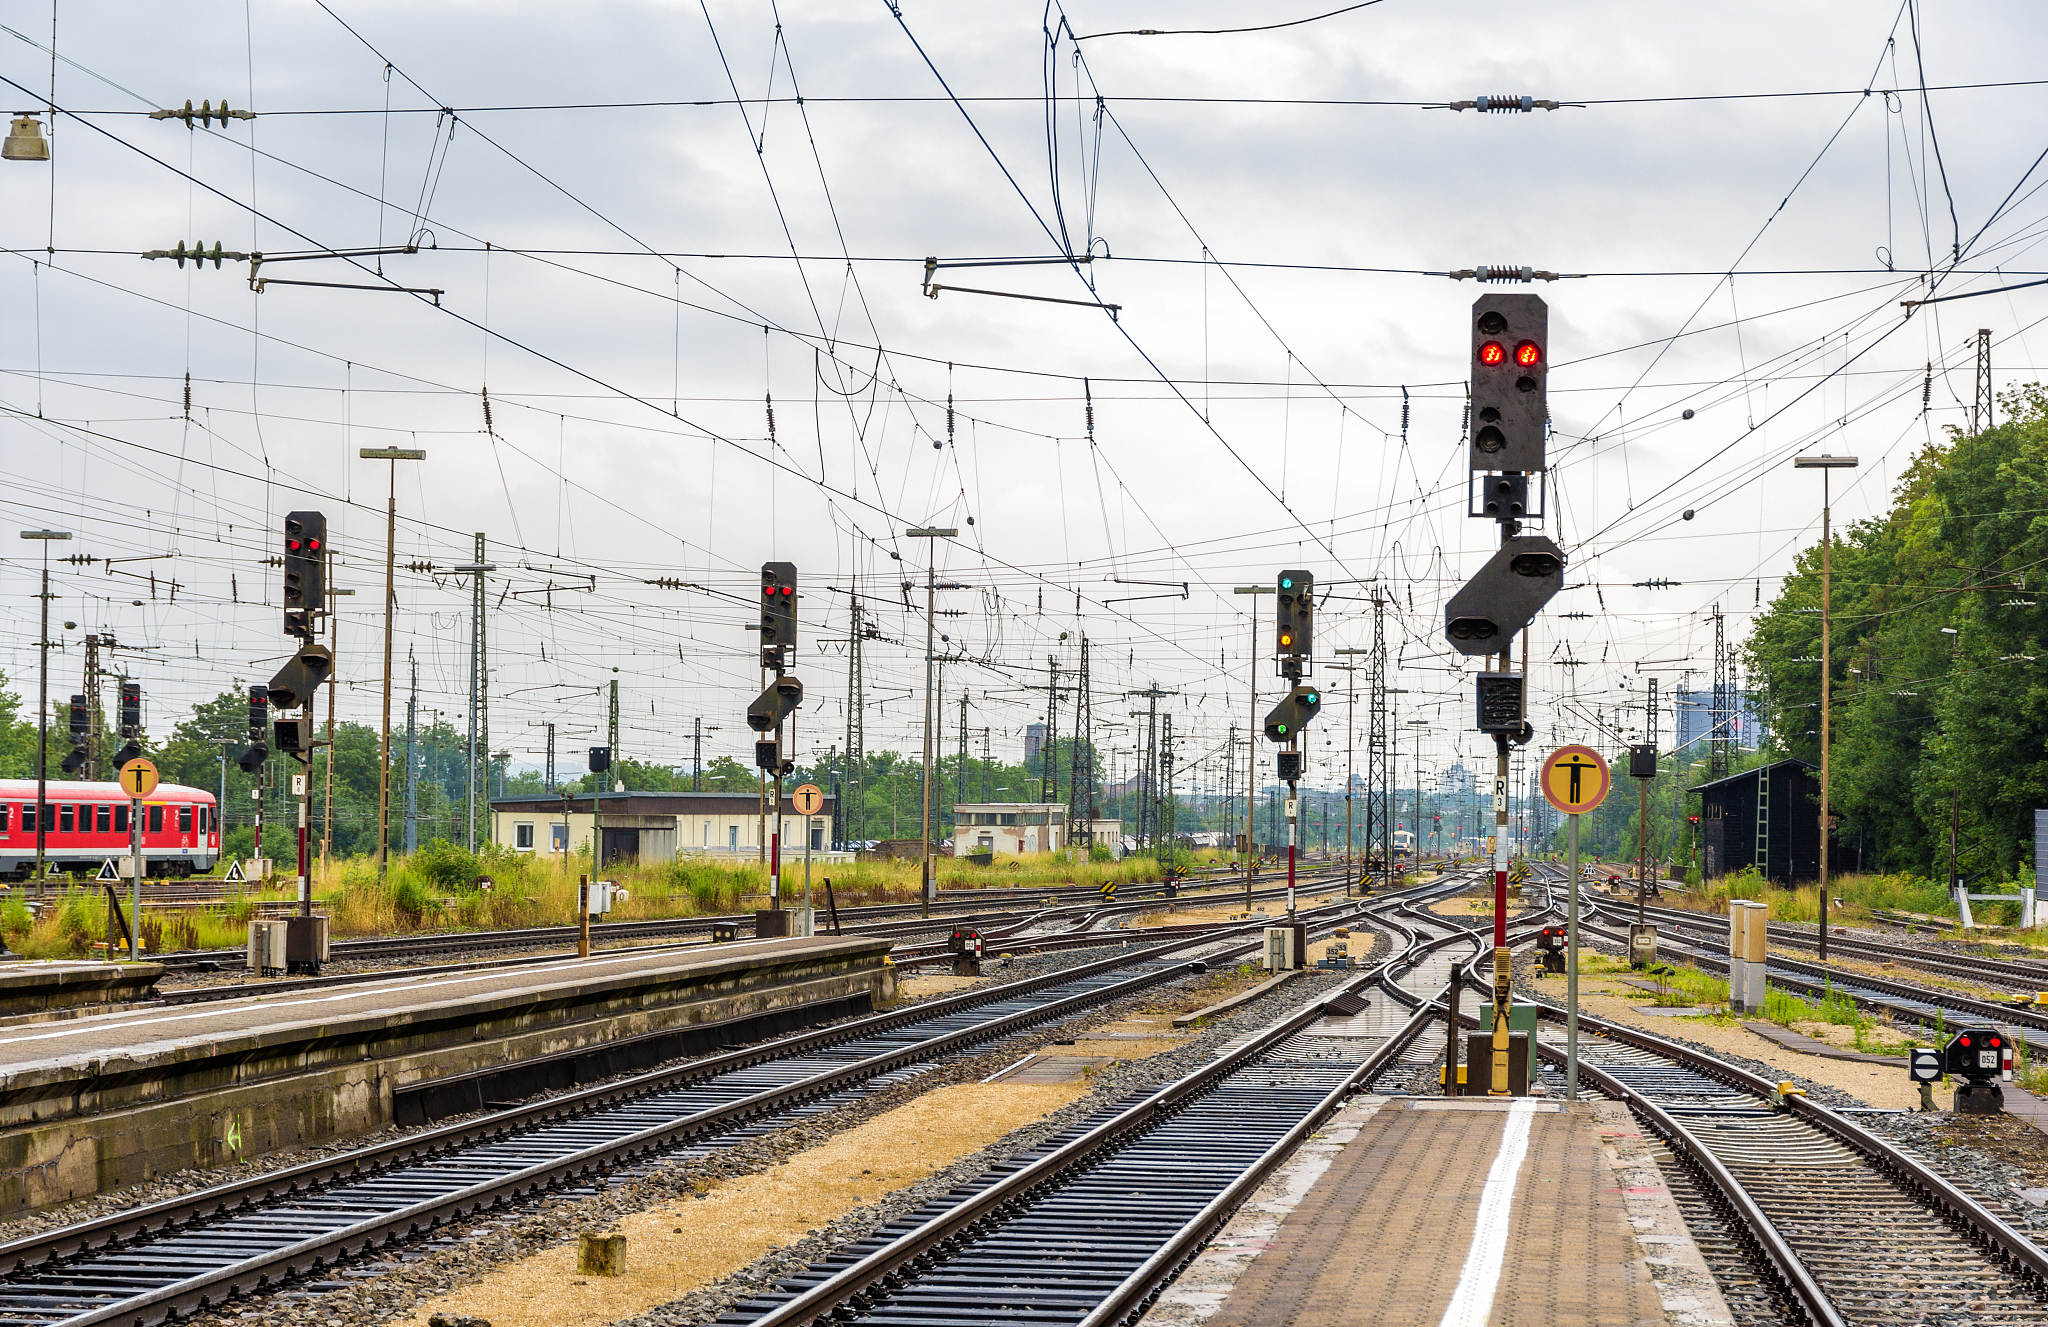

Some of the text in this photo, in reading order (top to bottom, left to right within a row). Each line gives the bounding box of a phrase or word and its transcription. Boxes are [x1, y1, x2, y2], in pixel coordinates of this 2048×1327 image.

[297, 777, 302, 786] R
[1496, 780, 1505, 796] R
[770, 790, 775, 798] R
[1288, 801, 1294, 810] R
[1497, 797, 1503, 807] 3
[9, 807, 14, 819] 2
[163, 809, 167, 820] 1
[174, 809, 179, 820] 2
[104, 866, 111, 878] 4
[232, 867, 239, 880] 4
[1981, 1055, 1995, 1064] 052
